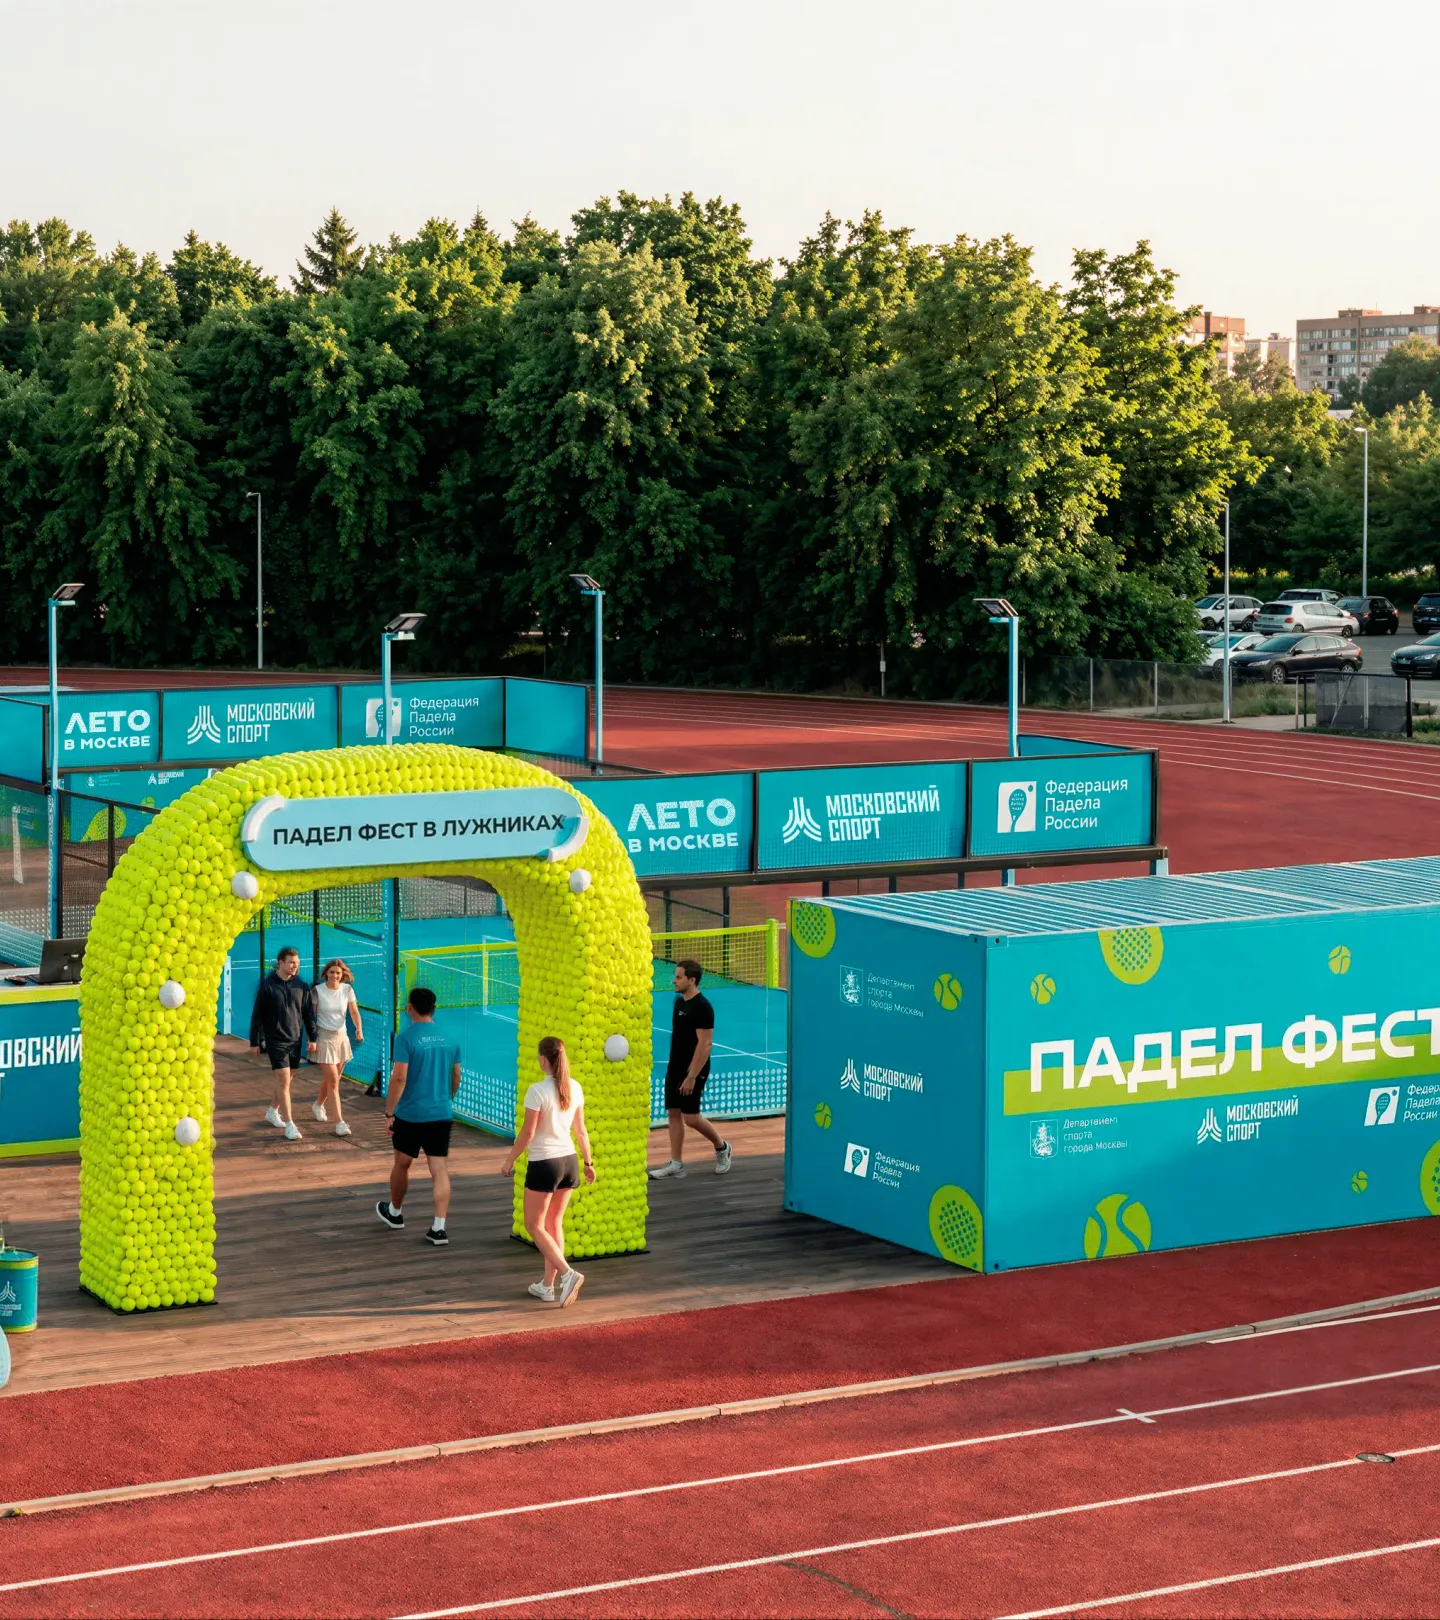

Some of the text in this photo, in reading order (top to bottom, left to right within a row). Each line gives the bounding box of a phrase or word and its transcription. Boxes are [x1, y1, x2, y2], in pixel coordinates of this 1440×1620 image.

[227, 698, 315, 722] МОСКОВСКИЙ
[409, 697, 479, 710] Федерация
[64, 709, 151, 734] ЛЕТО
[409, 711, 456, 724] Падела
[227, 724, 271, 743] СПОРТ
[409, 725, 454, 737] России
[64, 735, 151, 750] В МОСКВЕ
[1045, 779, 1128, 796] Федерация
[826, 785, 941, 818] МОСКОВСКИЙ
[1045, 797, 1101, 813] Падела
[627, 798, 736, 832] ЛЕТО
[1045, 816, 1099, 830] России
[273, 814, 566, 846] ПАДЕЛ ФЕСТ В ЛУЖНИКАХ
[828, 817, 881, 842] СПОРТ
[628, 832, 739, 853] В МОСКВЕ
[1030, 1007, 1440, 1094] ПАДЕЛ ФЕСТ
[863, 1063, 923, 1093] МОСКОВСКИЙ
[864, 1081, 892, 1102] СПОРТ
[1407, 1084, 1440, 1096] Федер
[1226, 1094, 1299, 1123] МОСКОВСКИЙ
[1405, 1097, 1440, 1109] Падела
[1403, 1110, 1438, 1122] России
[1064, 1132, 1093, 1142] спорта
[1226, 1122, 1261, 1142] СПОРТ
[1064, 1140, 1128, 1155] города Москвы
[875, 1151, 920, 1172] Федерация
